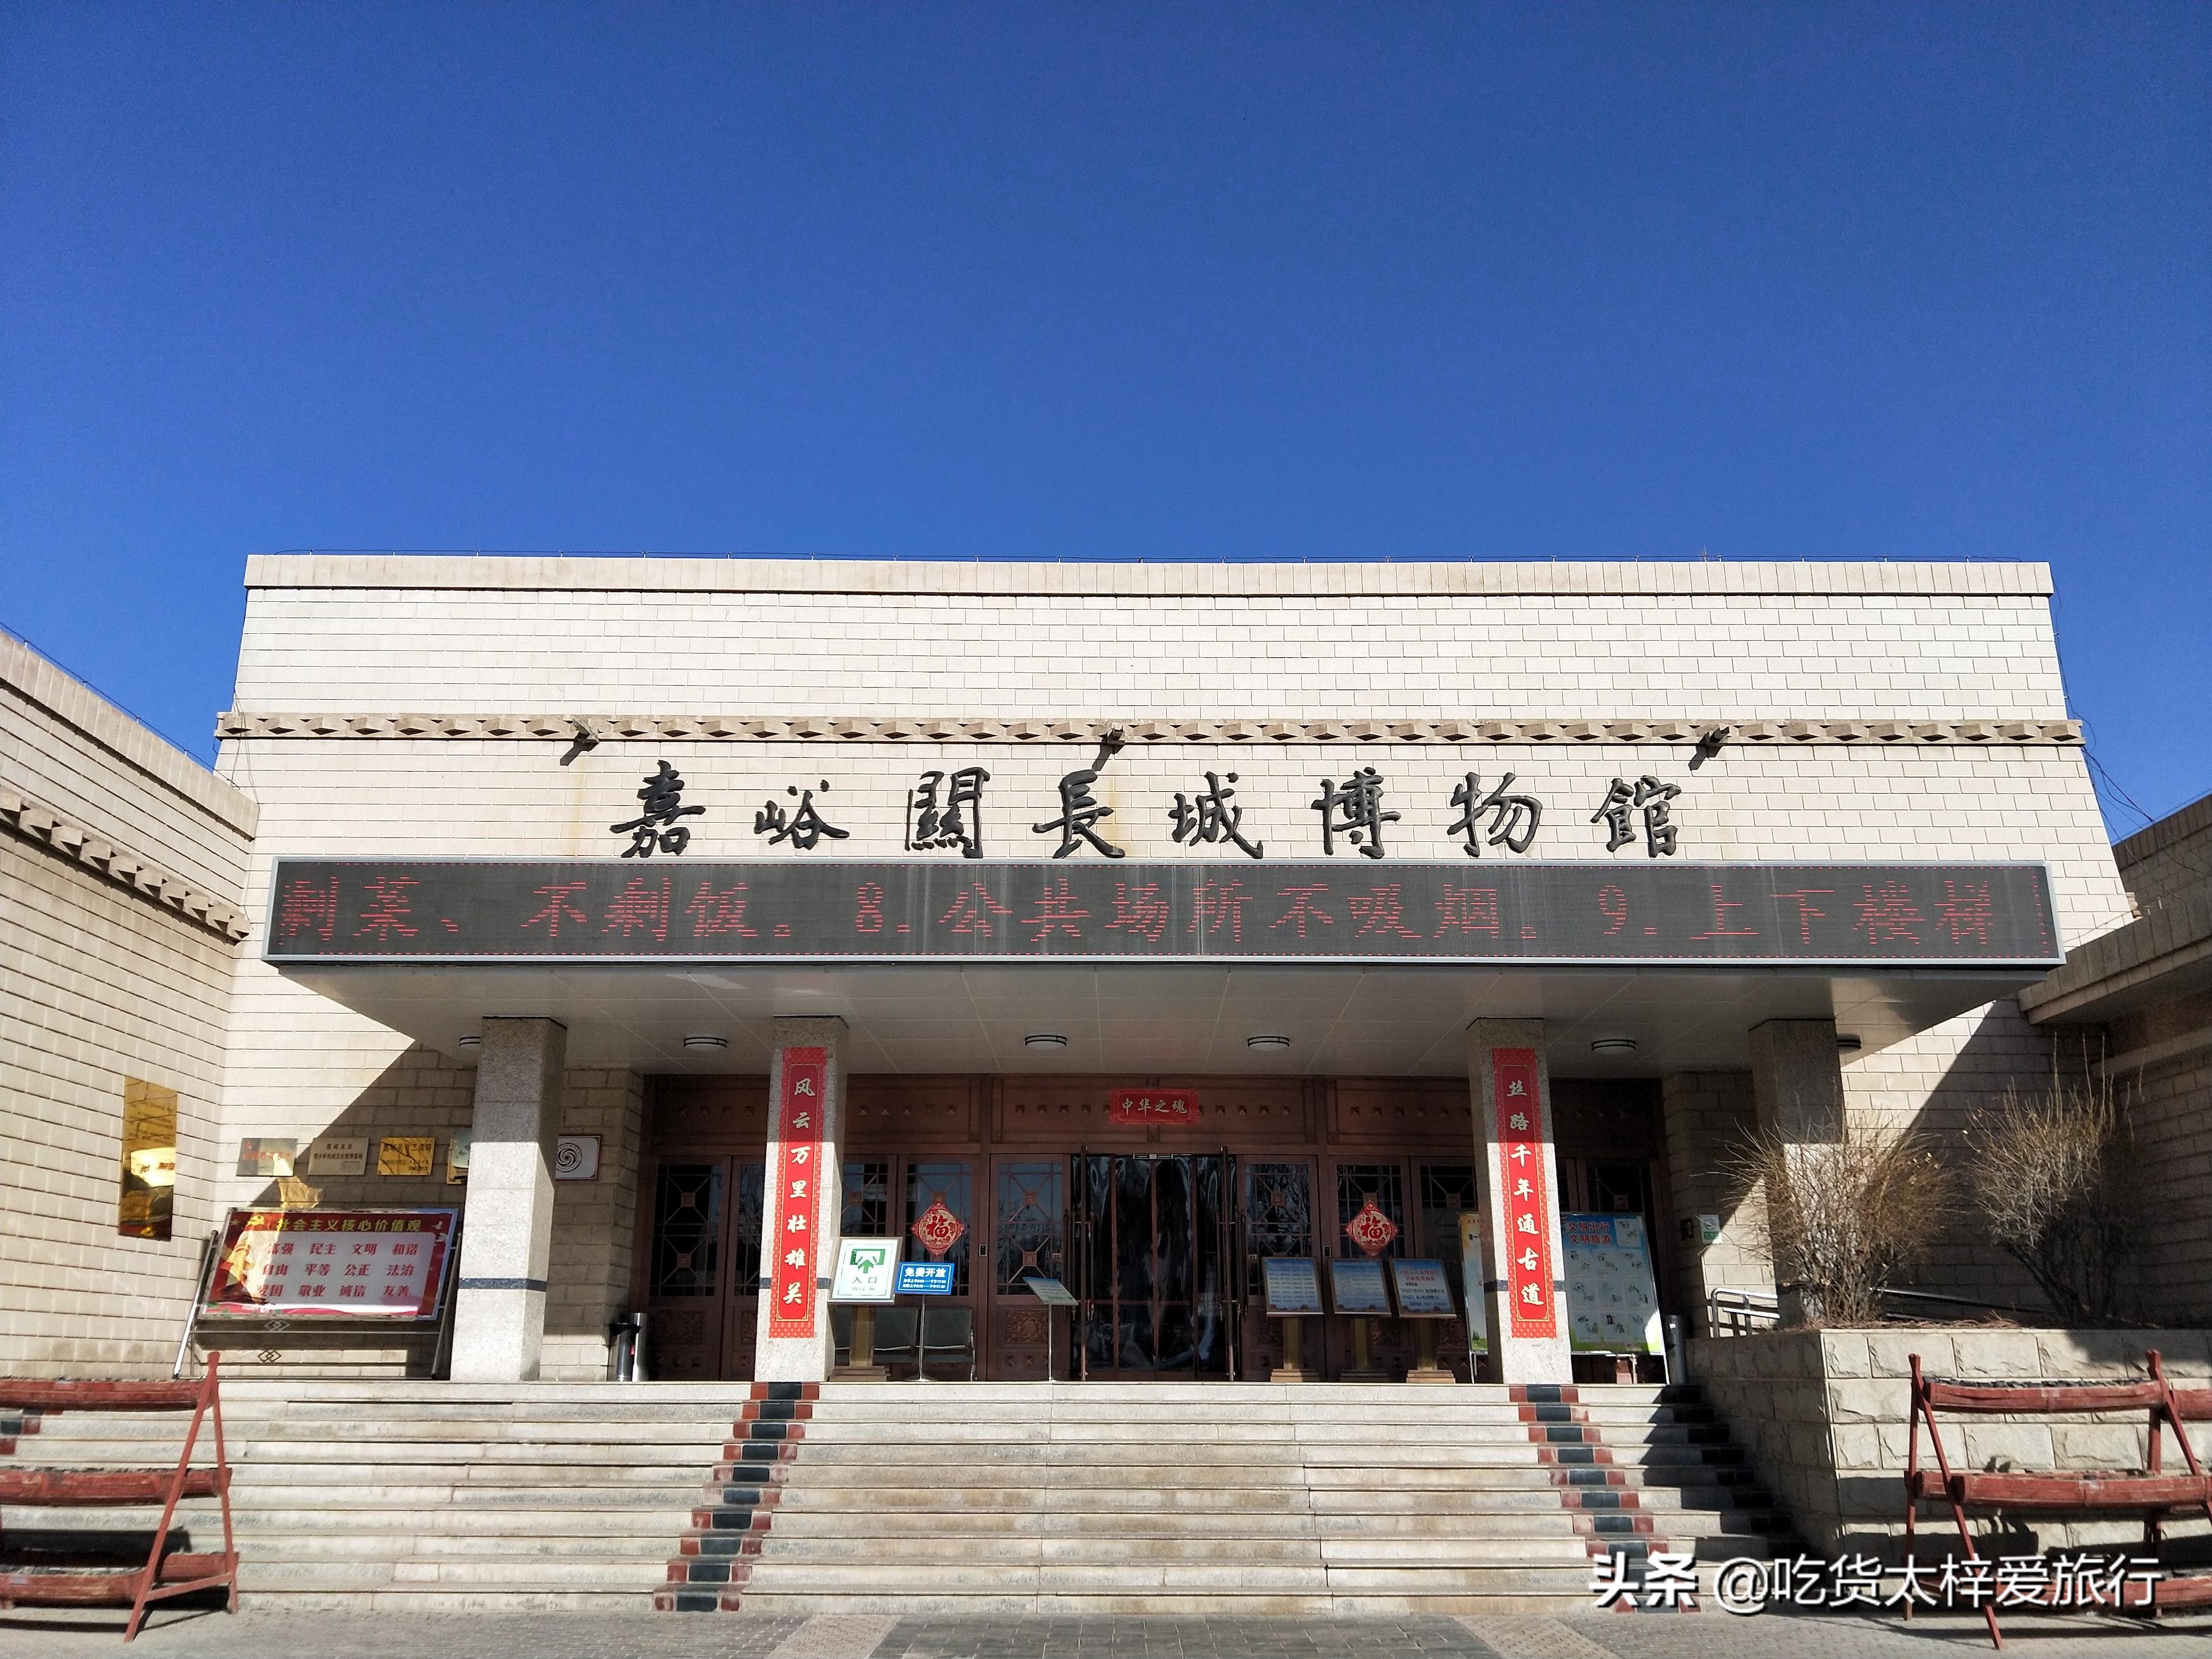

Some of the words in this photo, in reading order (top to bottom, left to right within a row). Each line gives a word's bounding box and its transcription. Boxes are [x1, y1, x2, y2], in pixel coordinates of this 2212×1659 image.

[1122, 1097, 1188, 1117] 中华之魂
[1506, 1079, 1545, 1306] 丝路千年通古道
[276, 1218, 422, 1232] 社会主义核心价值观
[927, 1215, 949, 1237] 福
[1361, 1216, 1383, 1239] 福
[1568, 1221, 1610, 1232] 文明出行
[1570, 1234, 1611, 1244] 文明旅游
[310, 1243, 337, 1255] 民主
[351, 1243, 377, 1255] 文明
[392, 1243, 418, 1255] 和谐
[262, 1264, 288, 1276] 自由
[303, 1264, 331, 1276] 平等
[344, 1264, 371, 1276] 公正
[387, 1264, 415, 1276] 法治
[904, 1267, 946, 1277] 免费开放
[298, 1285, 326, 1297] 敬业
[339, 1285, 366, 1297] 诚信
[383, 1285, 410, 1297] 友善
